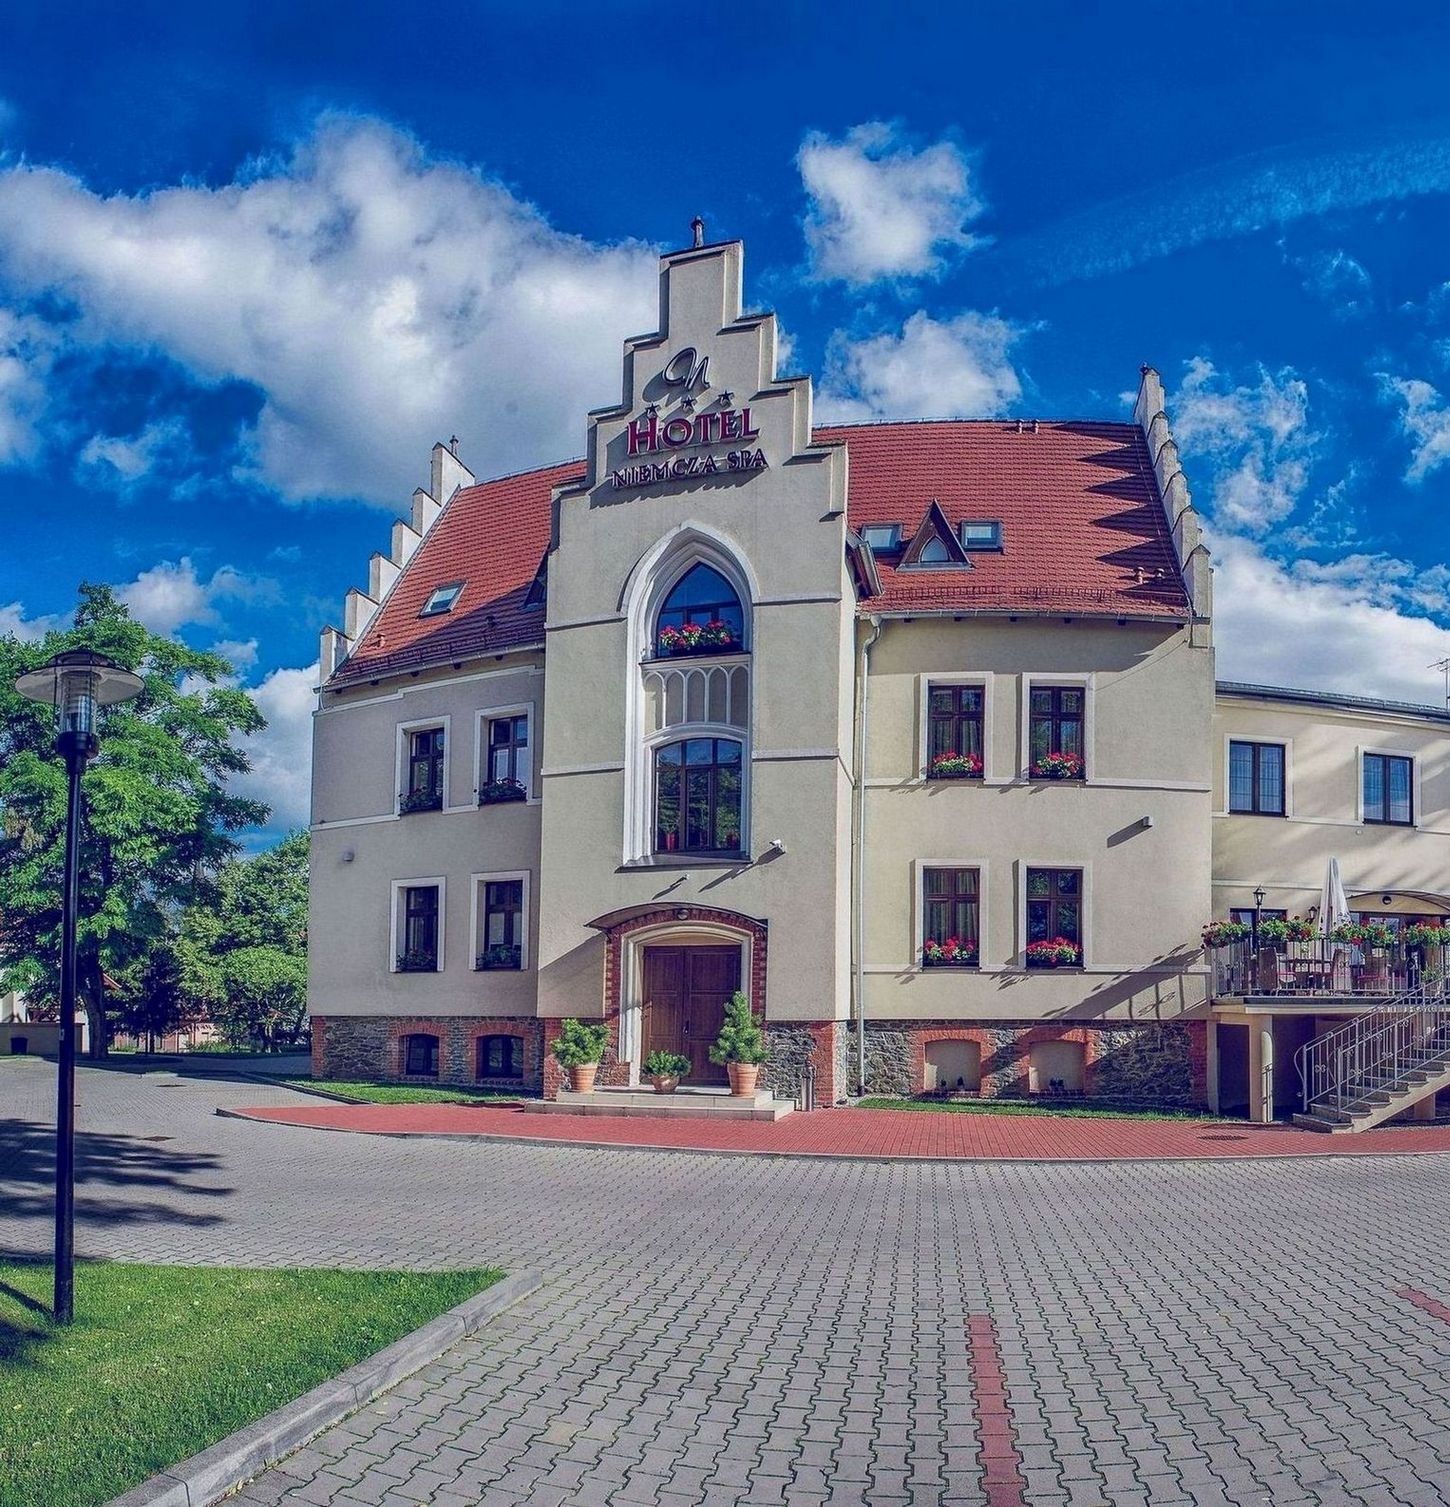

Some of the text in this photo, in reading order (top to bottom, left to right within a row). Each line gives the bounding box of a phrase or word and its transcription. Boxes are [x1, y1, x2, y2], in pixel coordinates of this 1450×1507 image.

[627, 408, 760, 456] HOTEL
[612, 448, 768, 488] NIEMCZA SPA
